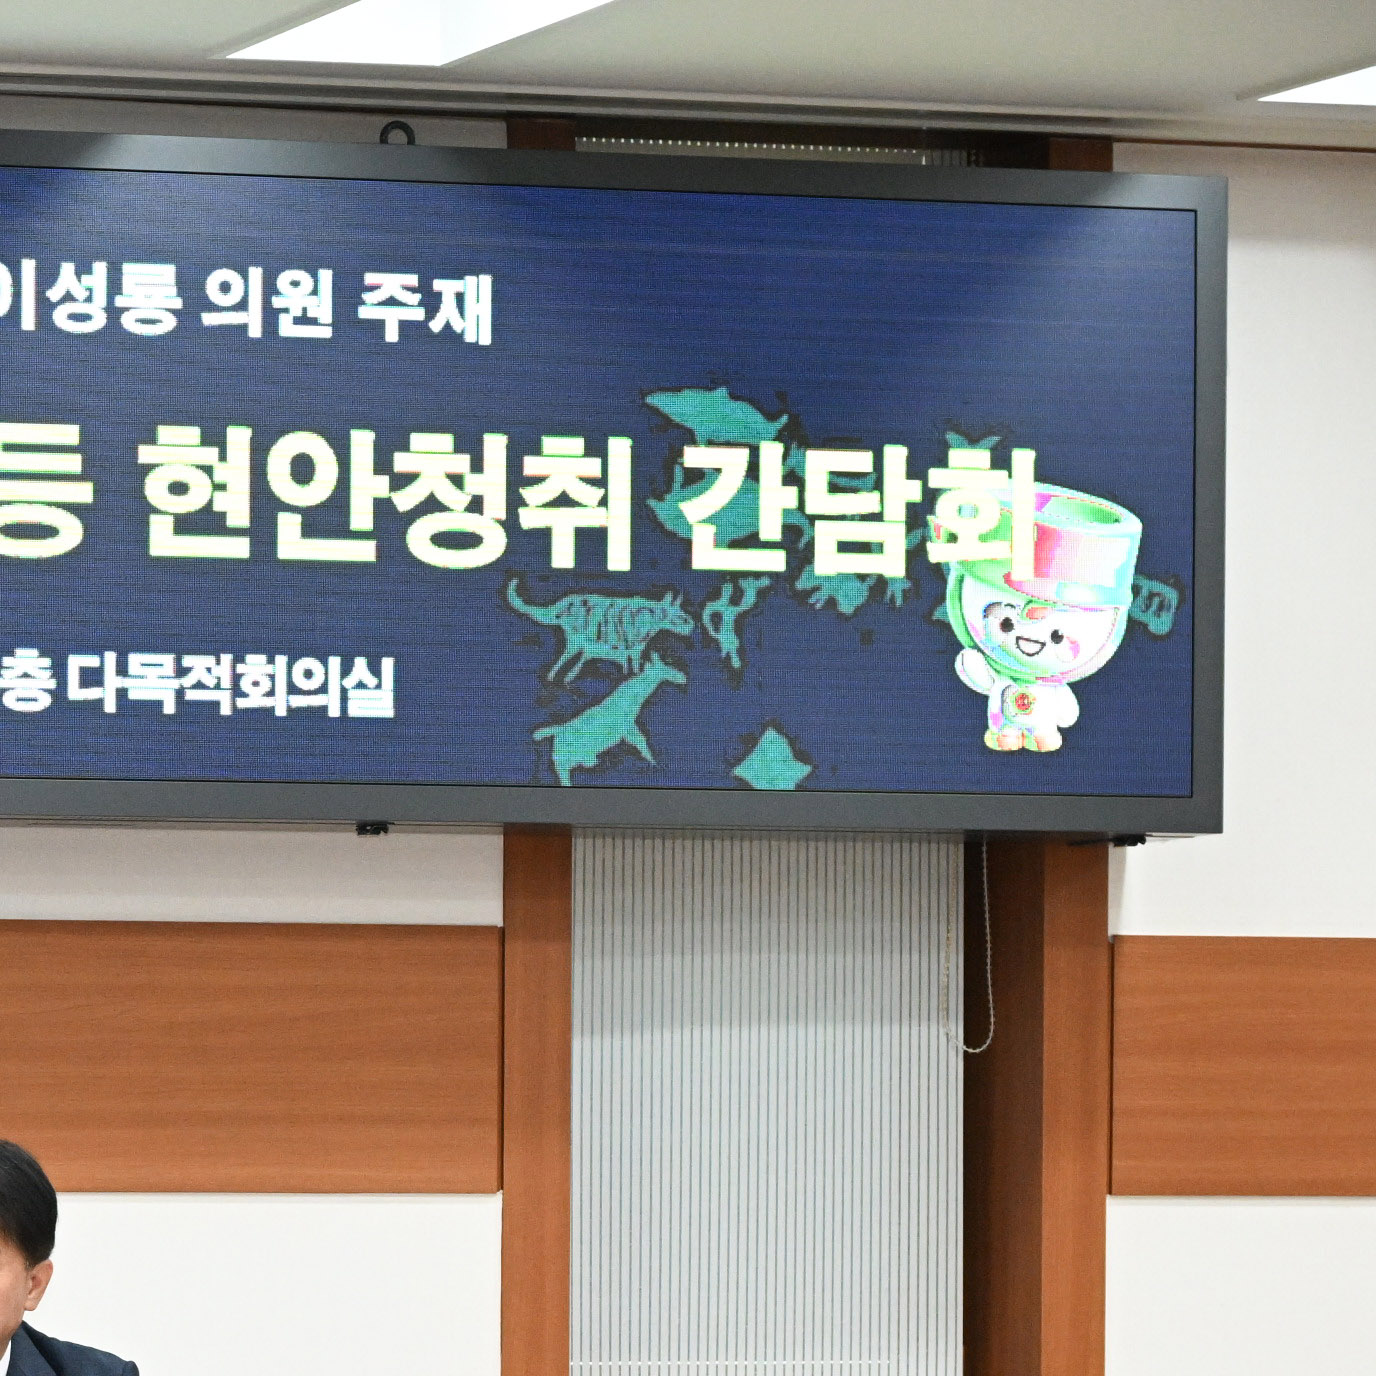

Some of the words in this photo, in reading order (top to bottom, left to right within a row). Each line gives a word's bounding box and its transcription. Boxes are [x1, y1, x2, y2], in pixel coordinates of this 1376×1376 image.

[200, 265, 334, 339] 의원
[357, 271, 493, 346] 주재
[136, 424, 633, 573] 현안청취
[678, 439, 1037, 582] 간담회
[66, 650, 396, 719] 다목적회의실
